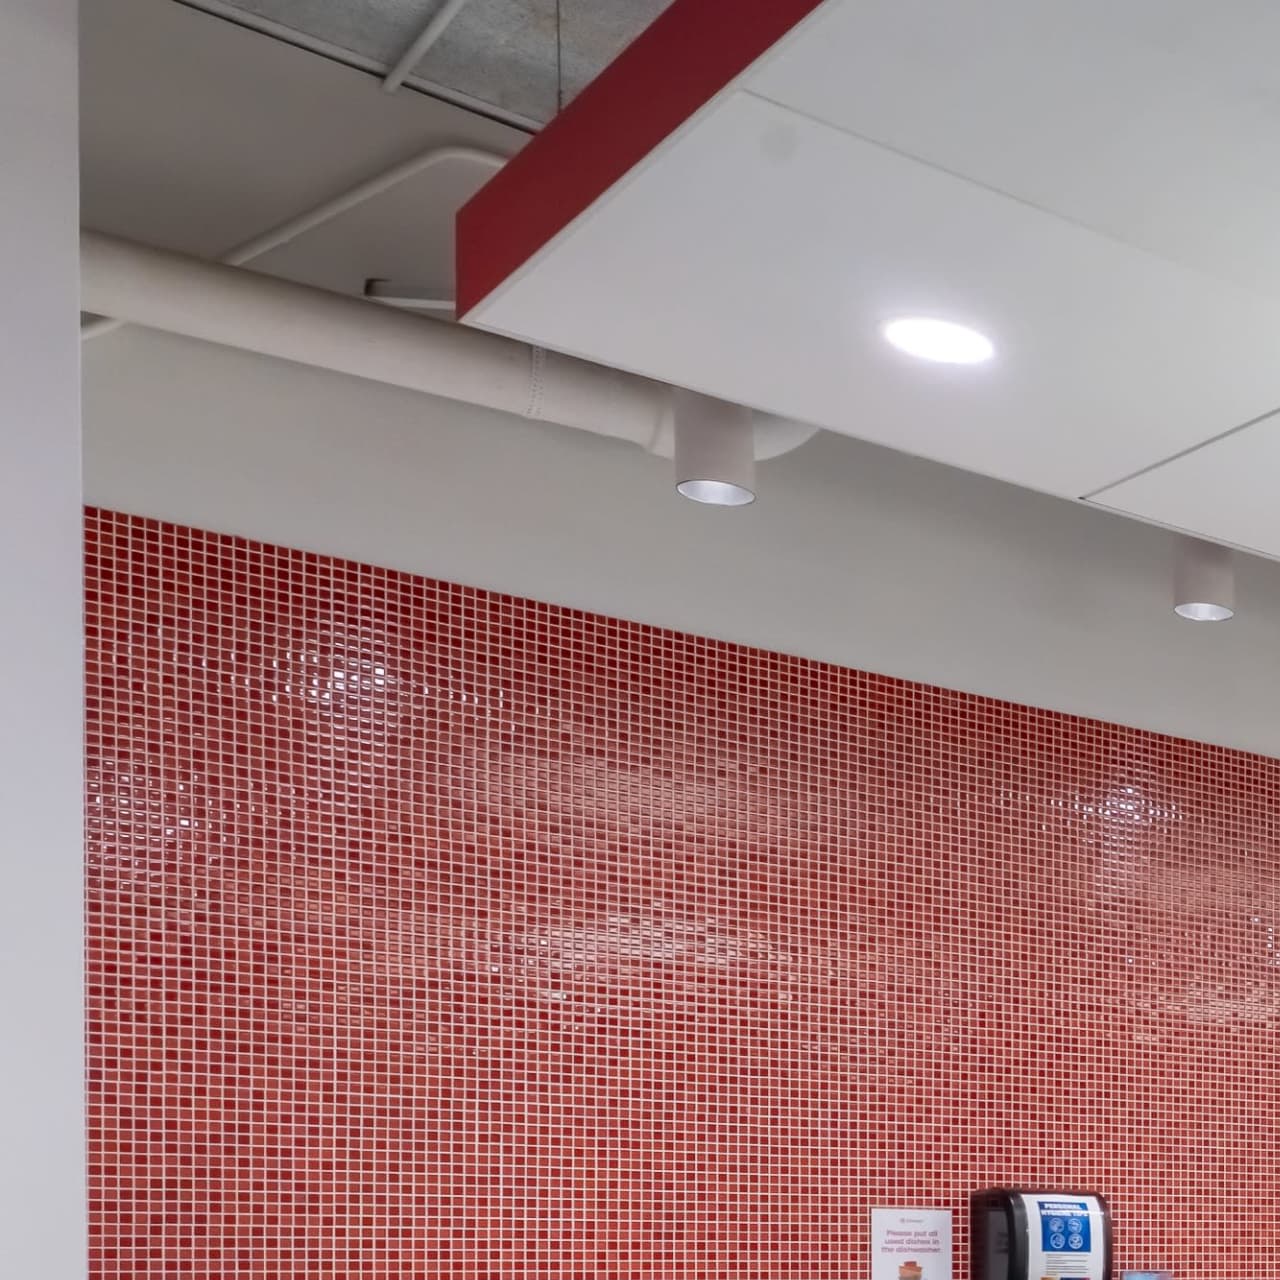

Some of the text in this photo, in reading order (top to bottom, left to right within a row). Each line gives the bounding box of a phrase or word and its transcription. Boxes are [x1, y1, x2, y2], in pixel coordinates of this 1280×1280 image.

[887, 1229, 938, 1238] Please put all
